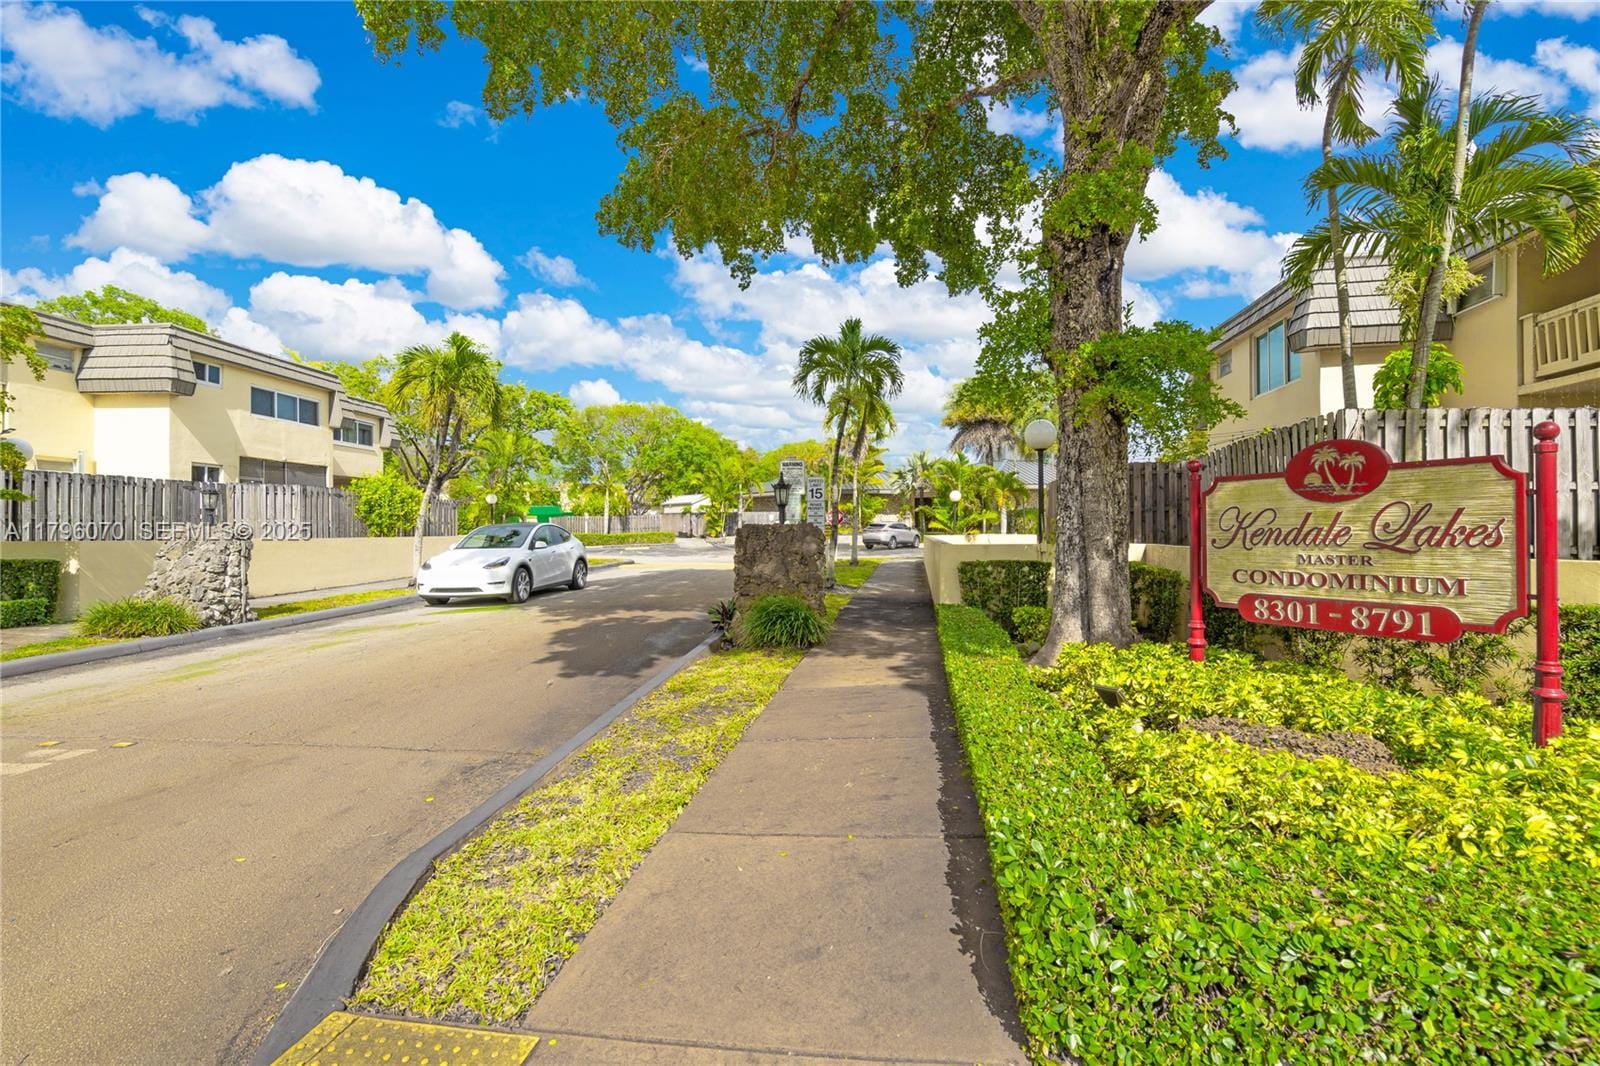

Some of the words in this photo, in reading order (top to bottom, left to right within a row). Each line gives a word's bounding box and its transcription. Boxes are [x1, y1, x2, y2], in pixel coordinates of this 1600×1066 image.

[809, 487, 823, 499] 15
[1211, 506, 1353, 551] Kendale
[1362, 500, 1507, 554] Lakes
[1297, 554, 1375, 567] MASTER
[1232, 568, 1470, 597] CONDOMINIUM
[1253, 598, 1321, 625] 8301
[1351, 605, 1436, 637] 8791
